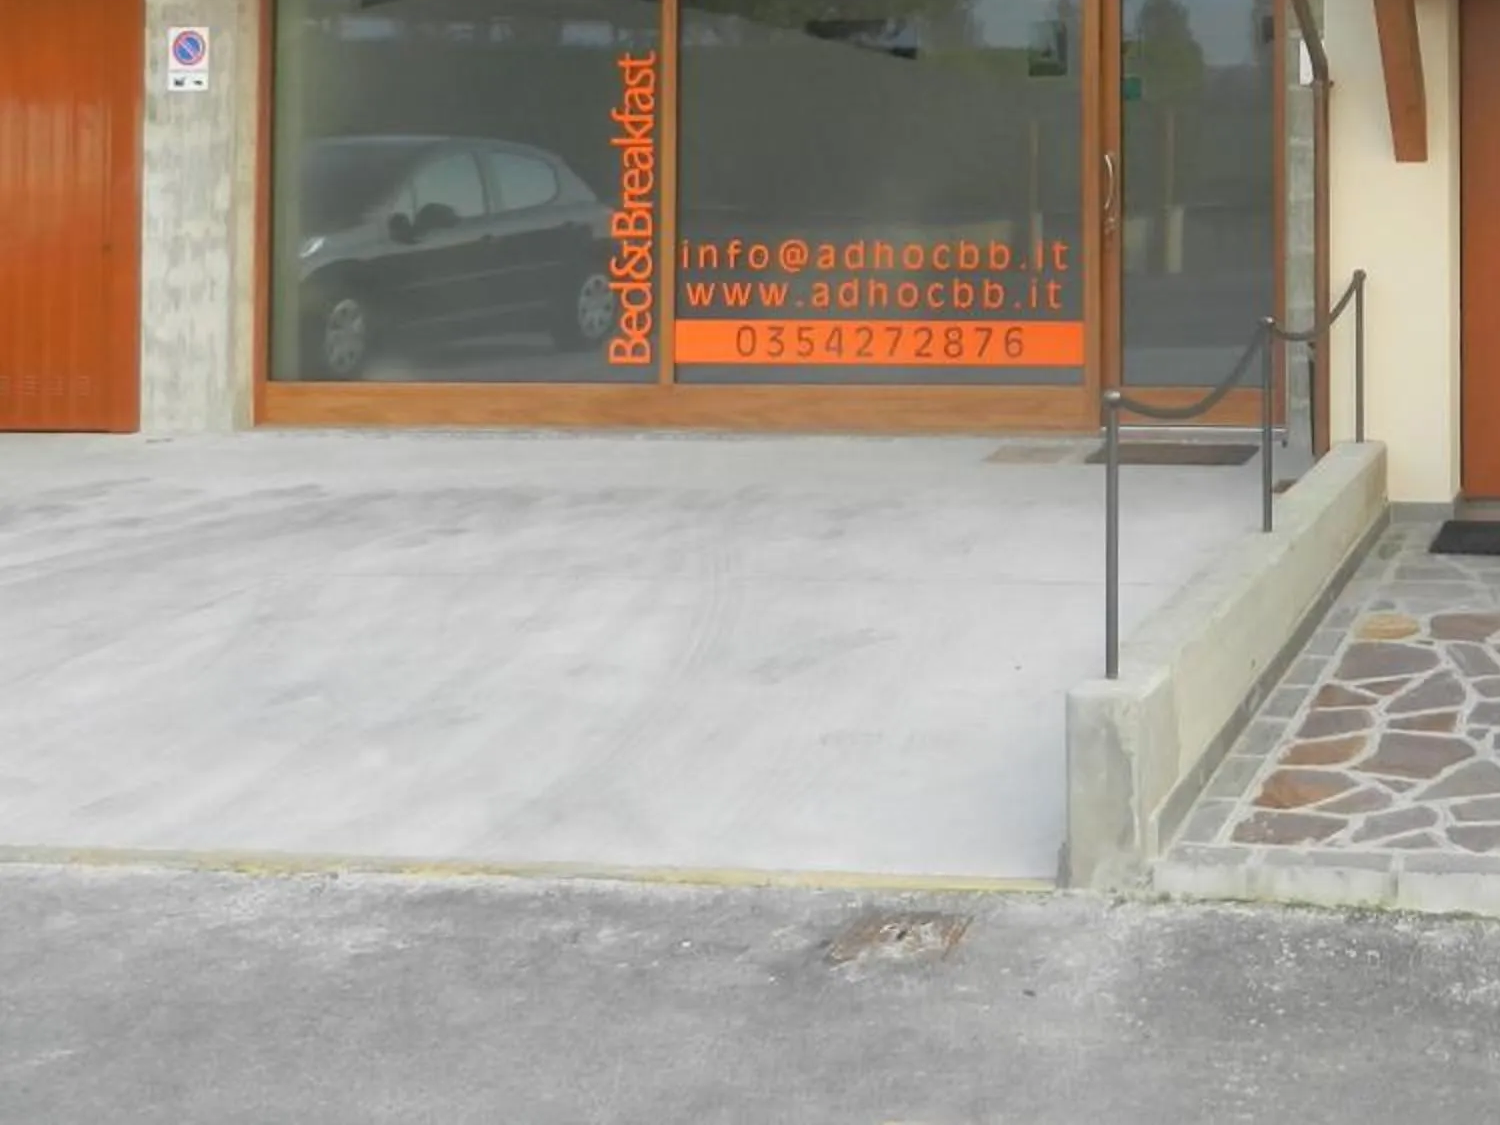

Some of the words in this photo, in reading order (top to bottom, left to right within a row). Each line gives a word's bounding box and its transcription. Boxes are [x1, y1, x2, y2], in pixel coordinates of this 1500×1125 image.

[608, 51, 656, 365] Bed&Breakfast
[681, 239, 1069, 272] info@adhocbb.it
[685, 278, 1062, 309] www.adhocbb.it
[735, 326, 1025, 359] 0354272876
